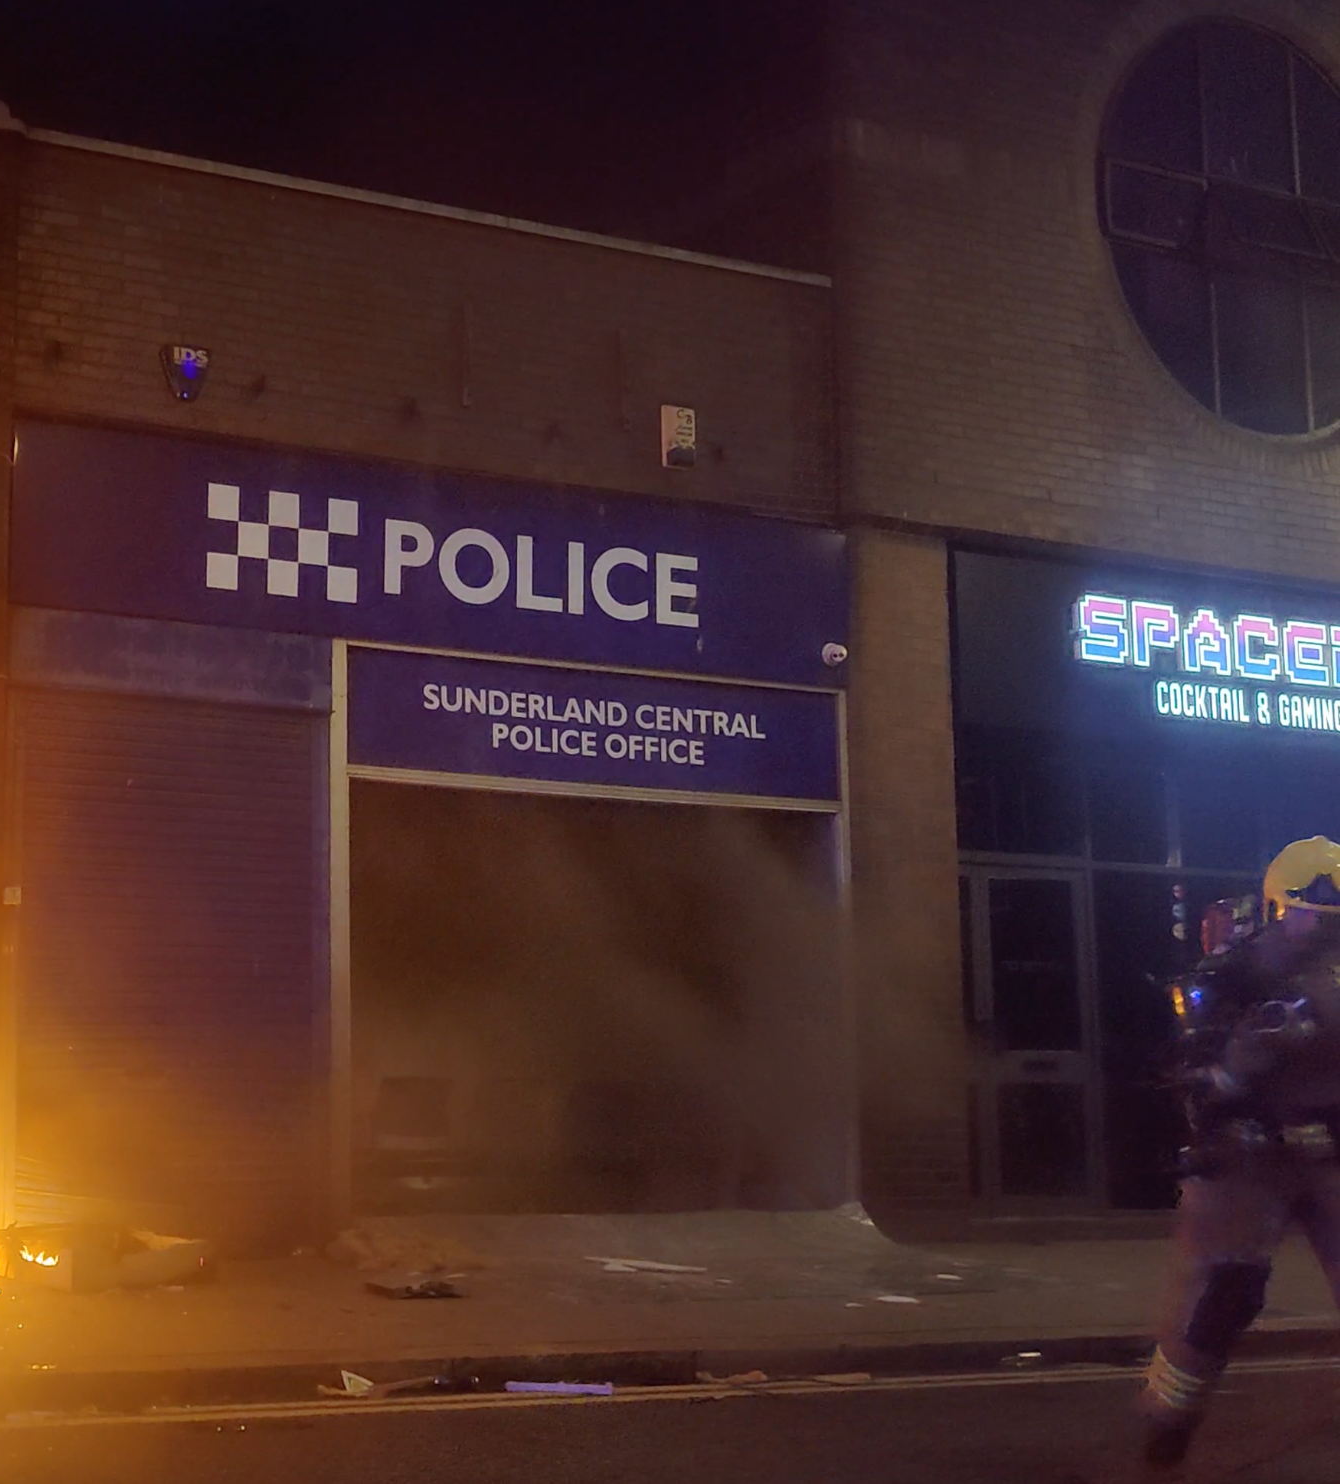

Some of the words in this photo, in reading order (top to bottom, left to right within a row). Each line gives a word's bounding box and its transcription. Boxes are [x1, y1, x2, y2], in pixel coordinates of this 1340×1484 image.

[173, 346, 208, 368] IDS
[383, 518, 699, 628] POLICE
[1078, 594, 1340, 688] SPACE
[423, 684, 627, 727] SUNDERLAND
[635, 705, 766, 739] CENTRAL
[1156, 681, 1250, 723] COCKTAIL
[1257, 692, 1271, 724] &
[492, 723, 597, 757] POLICE
[604, 734, 705, 766] OFFICE
